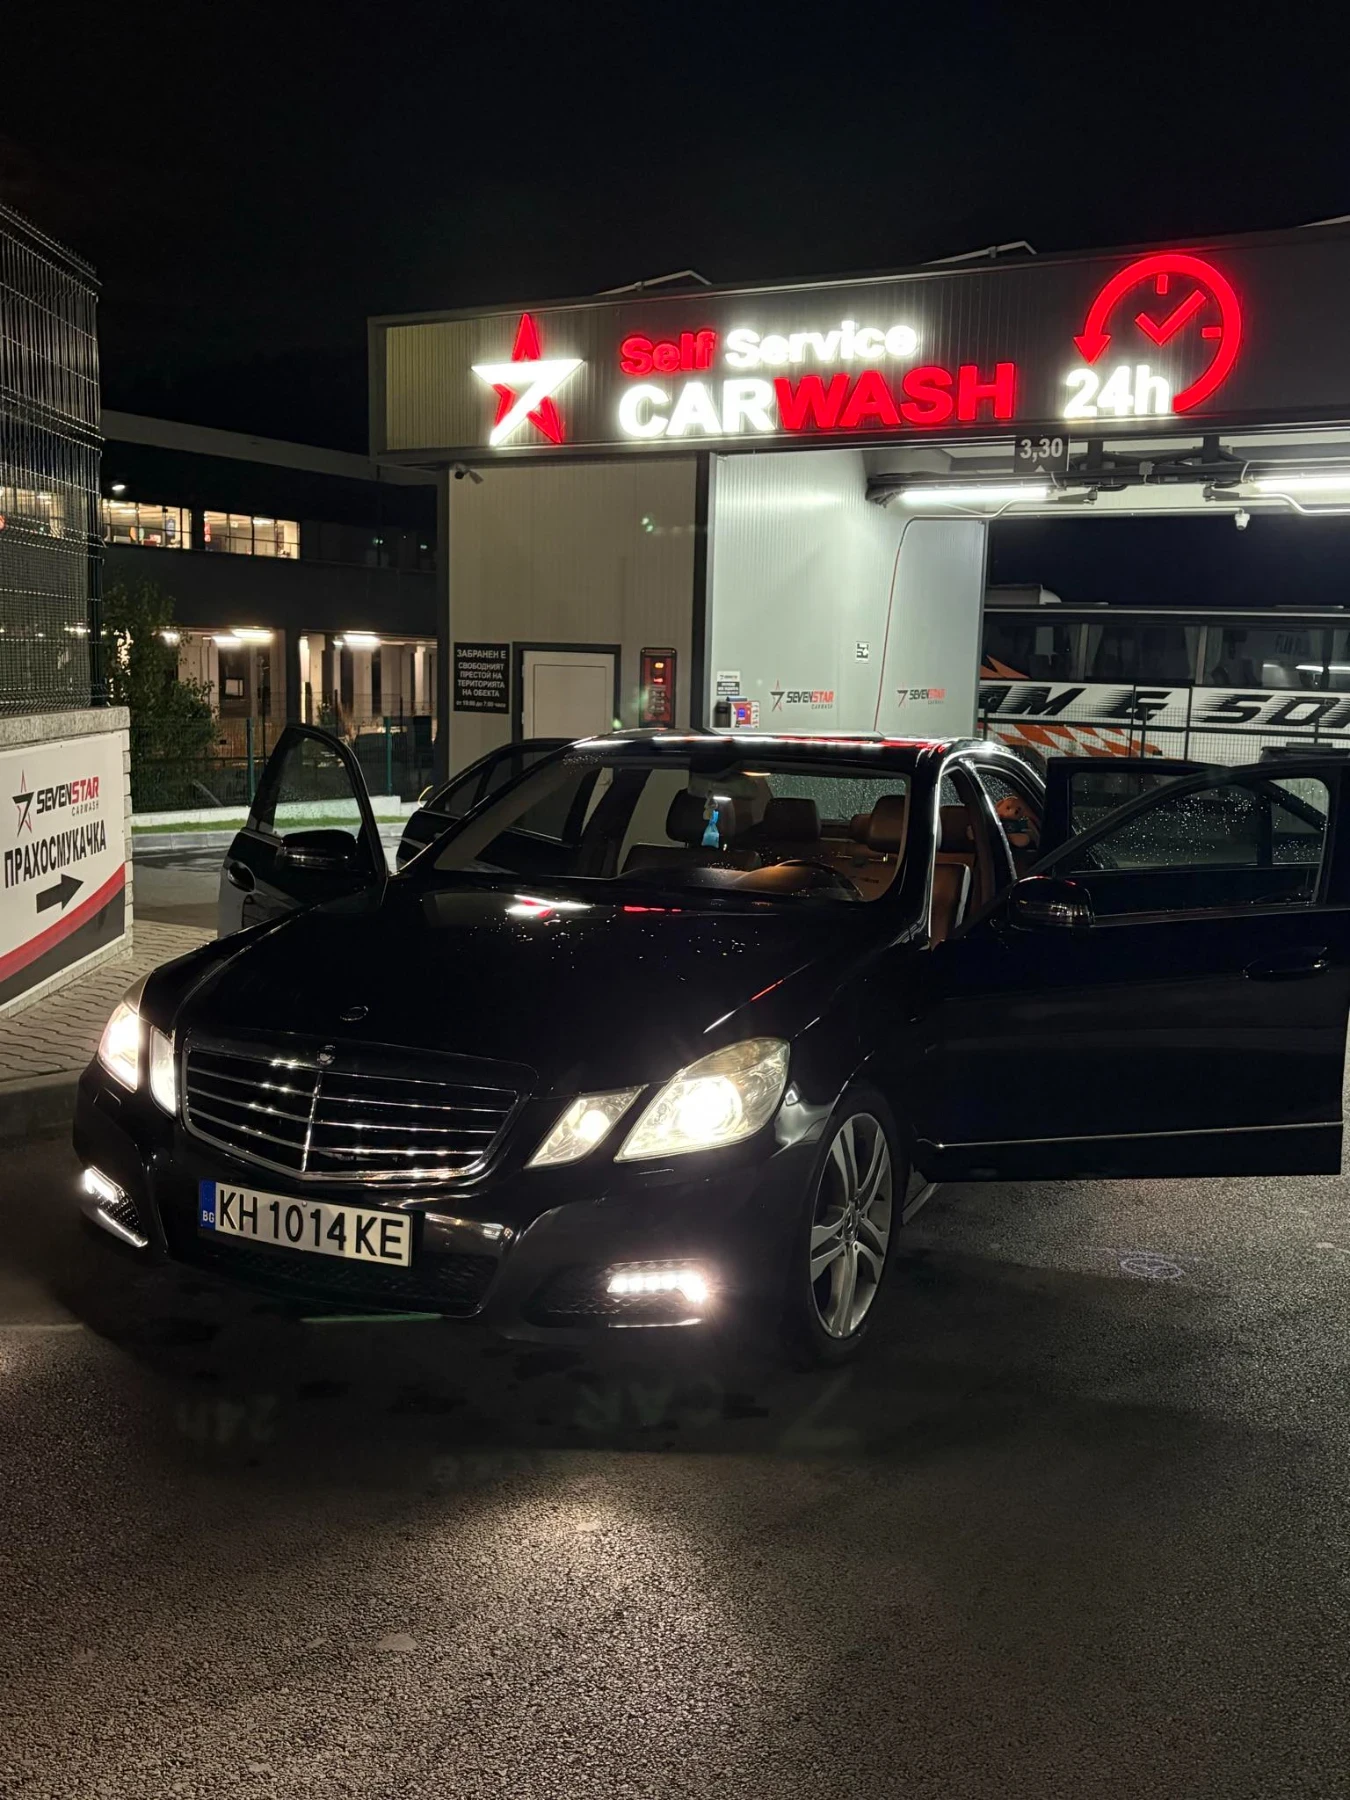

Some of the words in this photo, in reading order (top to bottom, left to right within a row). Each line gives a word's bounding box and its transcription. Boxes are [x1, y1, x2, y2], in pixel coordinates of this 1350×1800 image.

[619, 329, 717, 375] Self
[724, 319, 919, 368] Service
[618, 362, 1015, 438] CARWASH
[1063, 364, 1170, 418] 24h
[1019, 437, 1063, 462] 3,30
[456, 649, 499, 658] ЗАБРАНЕН
[458, 662, 504, 670] СВОБОДНИЯТ
[460, 671, 491, 679] ПРЕСТОЙ
[457, 679, 505, 688] ТЕРИТОРИЯТА
[462, 688, 472, 696] НА
[473, 689, 500, 697] ОБЕКТА
[36, 776, 100, 815] SEVENSTAR
[71, 800, 100, 816] CARWASH
[4, 819, 107, 889] ПРАХОСМУКАЧКА
[202, 1209, 215, 1224] BG
[219, 1189, 259, 1235] KH
[269, 1200, 347, 1251] 1014
[355, 1214, 404, 1261] KE
